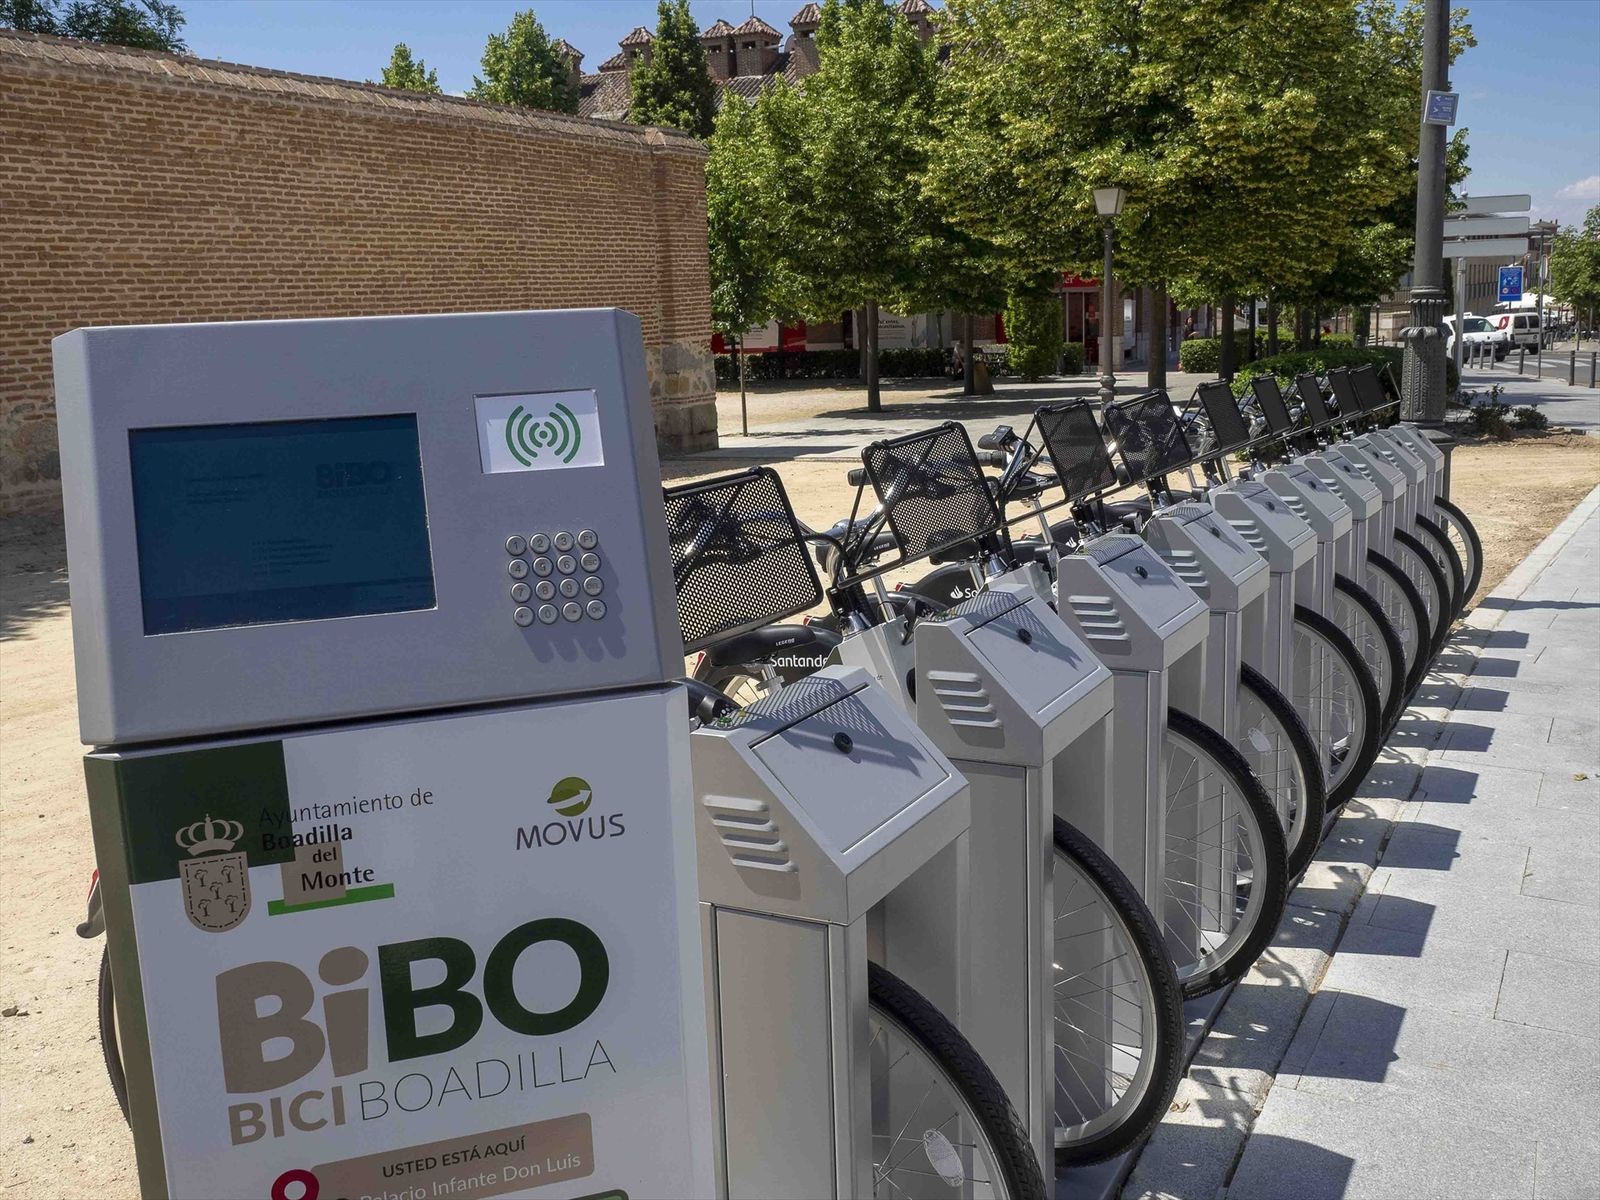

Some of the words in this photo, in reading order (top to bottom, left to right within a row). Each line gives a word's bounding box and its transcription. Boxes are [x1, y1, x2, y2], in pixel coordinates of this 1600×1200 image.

[770, 654, 829, 668] Santande
[258, 793, 403, 829] Ayuntamiento
[410, 787, 434, 807] de
[262, 823, 354, 851] Boadilla
[515, 813, 626, 850] MOVUS
[312, 847, 337, 863] del
[301, 866, 375, 892] Monte
[215, 917, 610, 1094] BiBO
[228, 1085, 347, 1146] BICI
[358, 1039, 617, 1121] BOADILLA
[382, 1157, 437, 1178] USTED
[441, 1145, 483, 1168] ESTÁ
[483, 1135, 526, 1161] AQUÍ
[432, 1171, 497, 1197] Infante
[503, 1163, 541, 1183] Don
[546, 1153, 582, 1173] Luis
